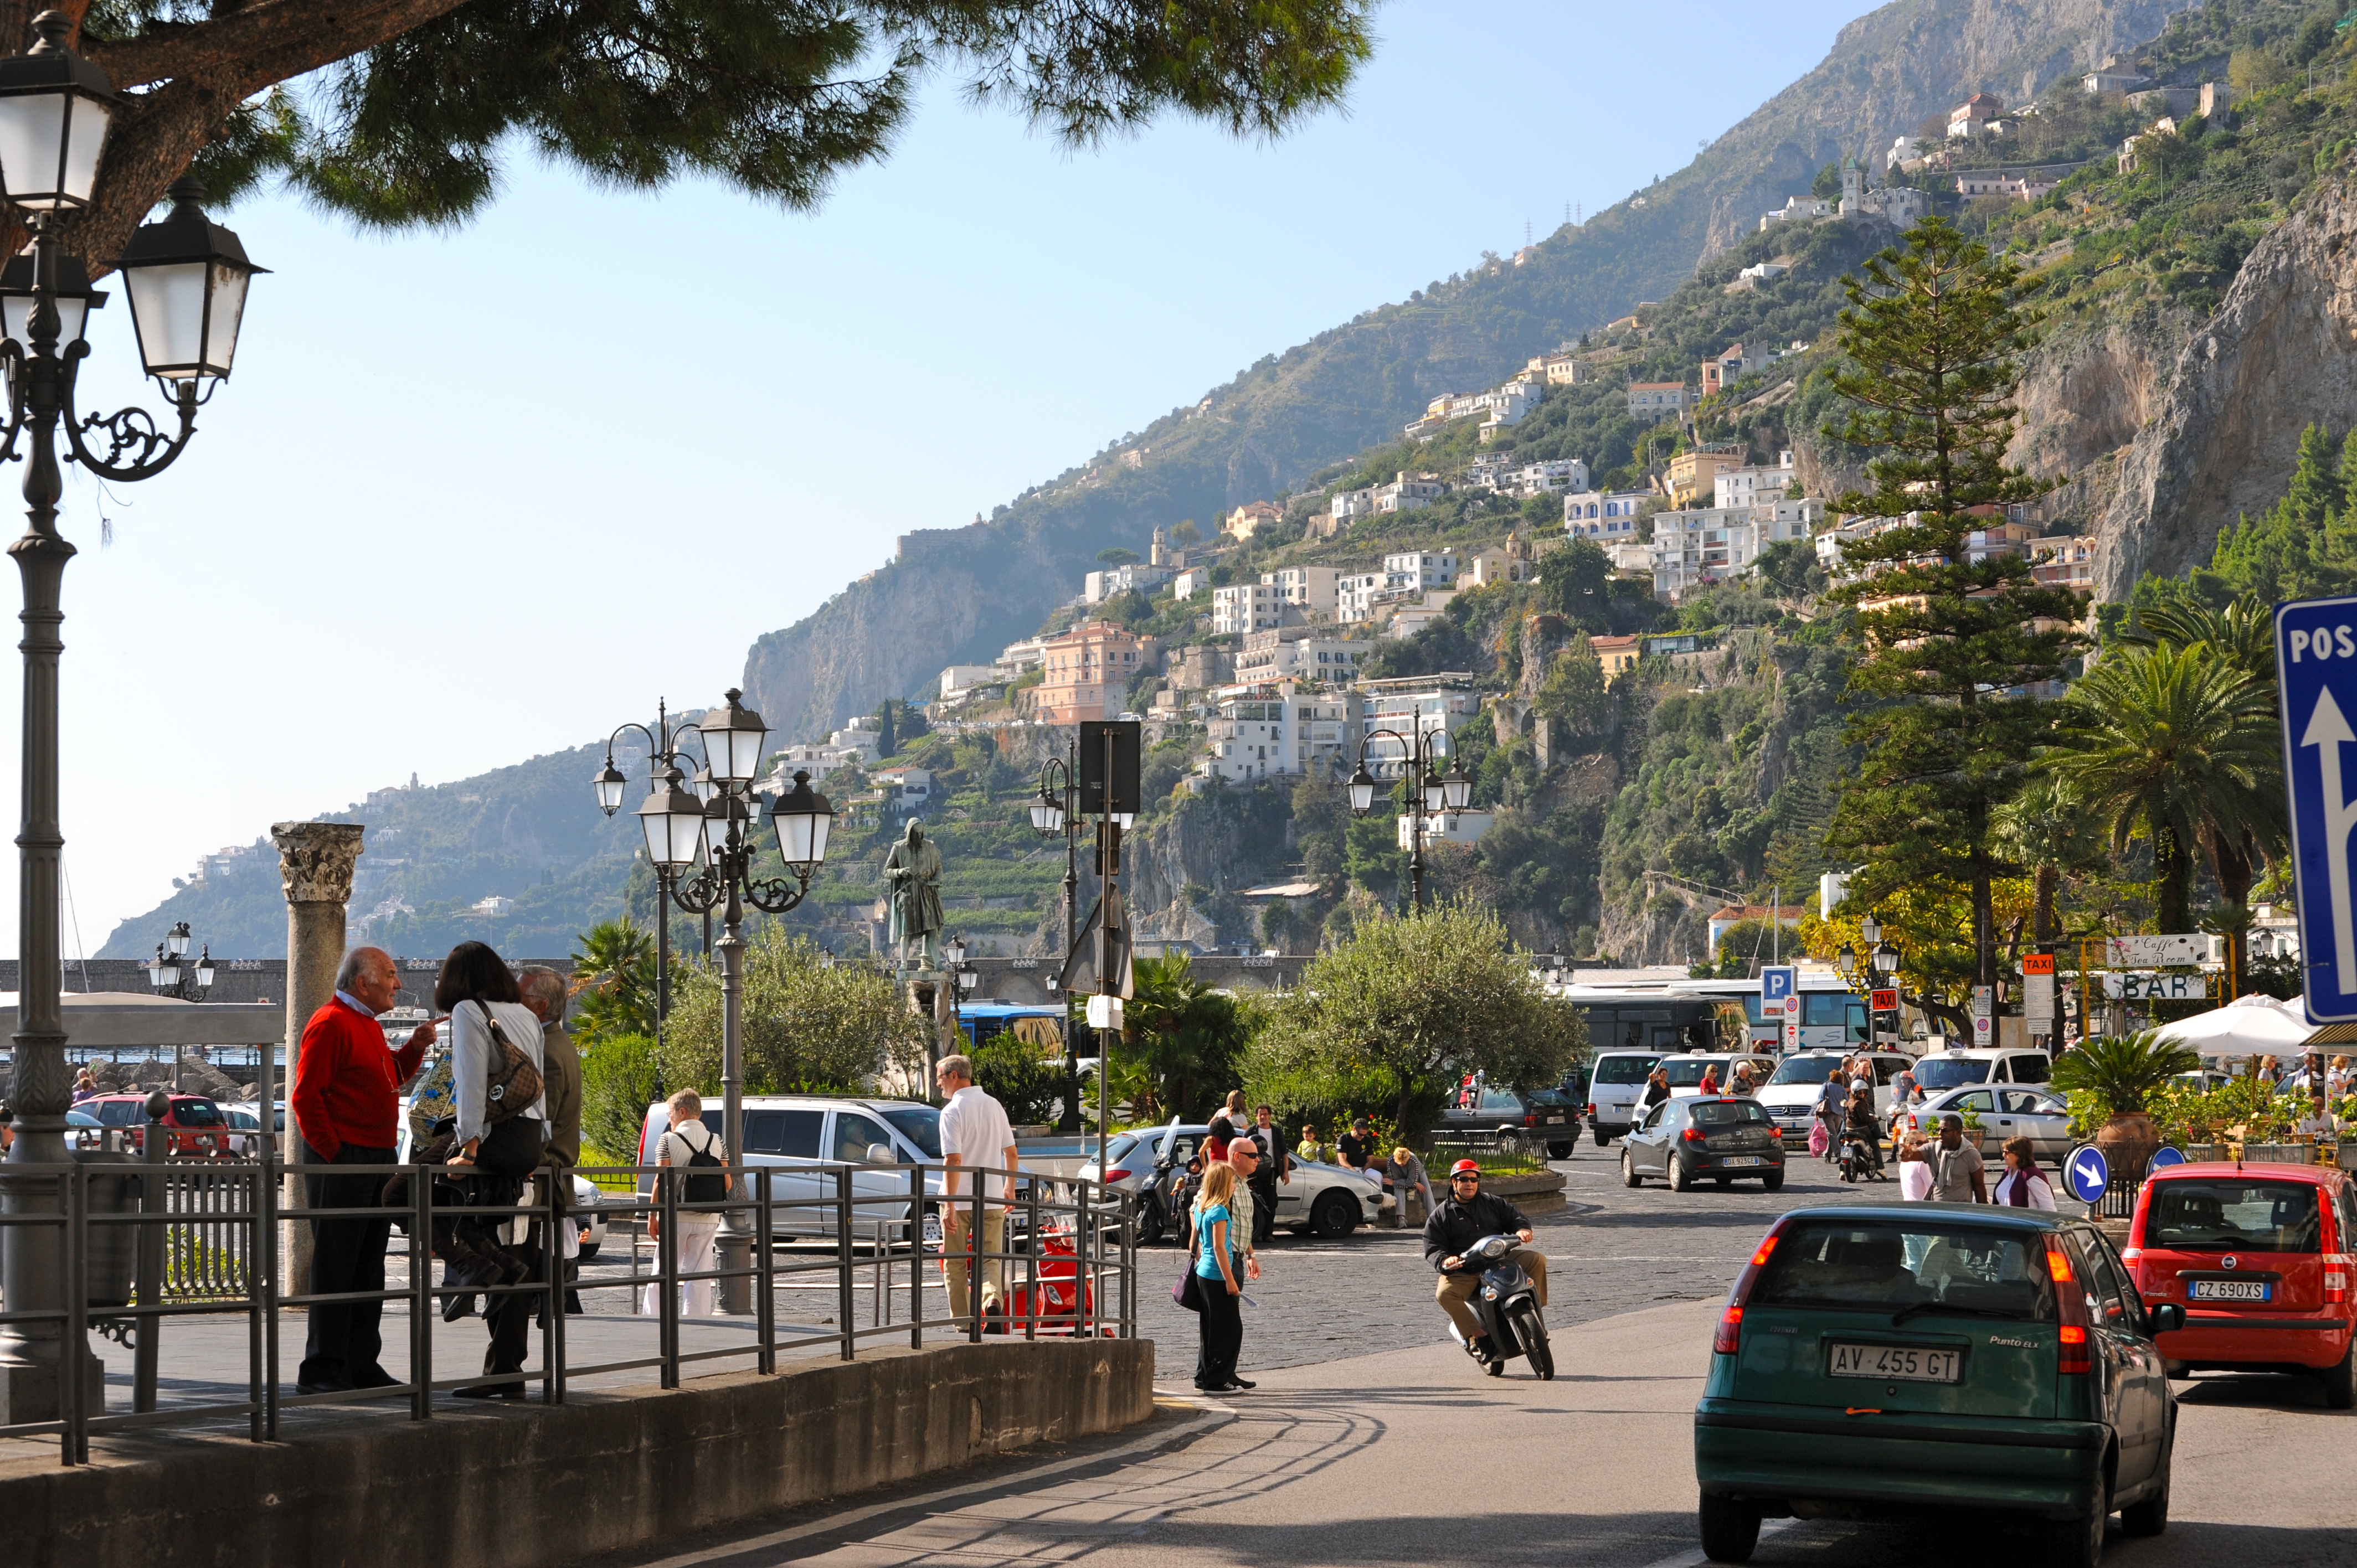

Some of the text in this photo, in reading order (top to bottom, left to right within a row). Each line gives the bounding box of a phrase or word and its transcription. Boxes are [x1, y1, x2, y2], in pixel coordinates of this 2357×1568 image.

[2026, 960, 2051, 969] TAXI
[2127, 952, 2186, 964] Tea Room
[1771, 974, 1784, 995] P
[2124, 974, 2187, 998] BAR
[1874, 993, 1895, 1007] TAXI
[2197, 1282, 2262, 1298] CZ 690XS
[1989, 1335, 2022, 1347] Punto
[1836, 1348, 1863, 1370] AV
[1876, 1350, 1918, 1374] 455
[1927, 1353, 1954, 1379] GT
